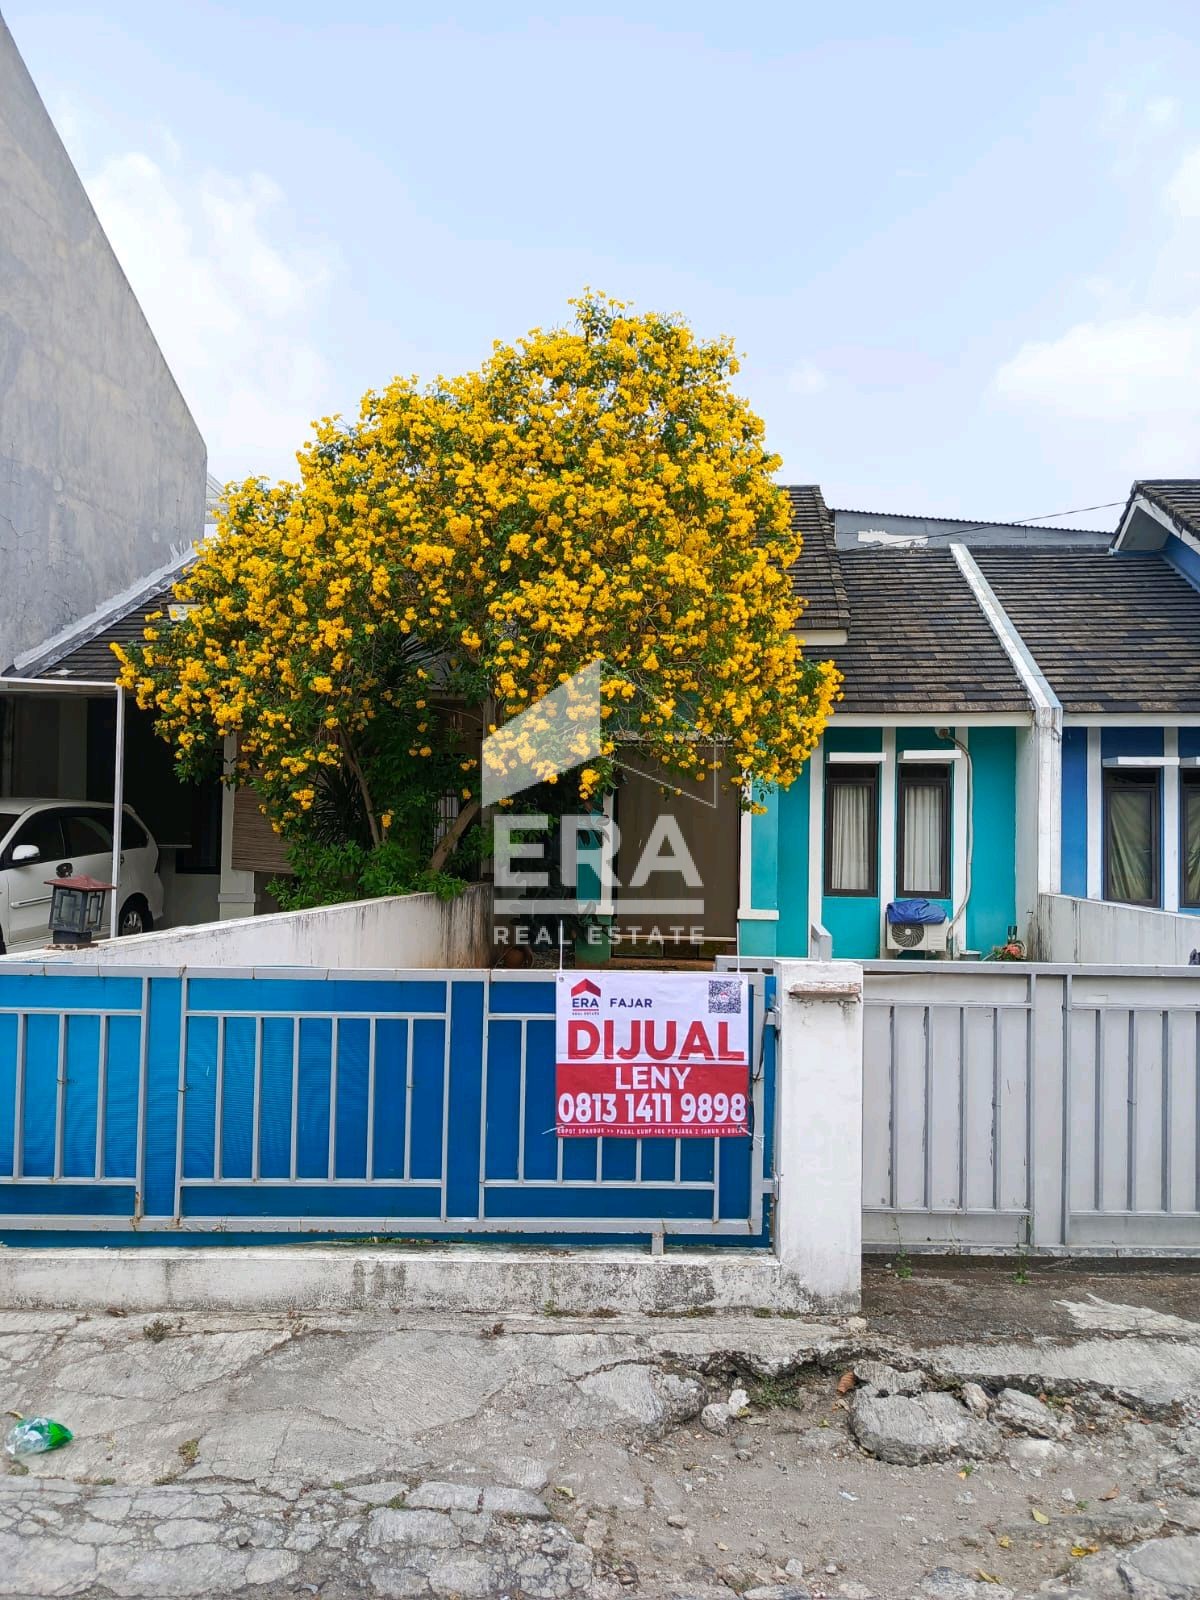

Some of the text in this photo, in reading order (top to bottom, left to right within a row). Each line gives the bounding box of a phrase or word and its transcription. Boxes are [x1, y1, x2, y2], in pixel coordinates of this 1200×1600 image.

[572, 998, 653, 1008] ERA FAJAR
[567, 1020, 745, 1061] DIJUAL
[615, 1066, 691, 1090] LENY
[558, 1092, 746, 1123] 0813 1411 9898
